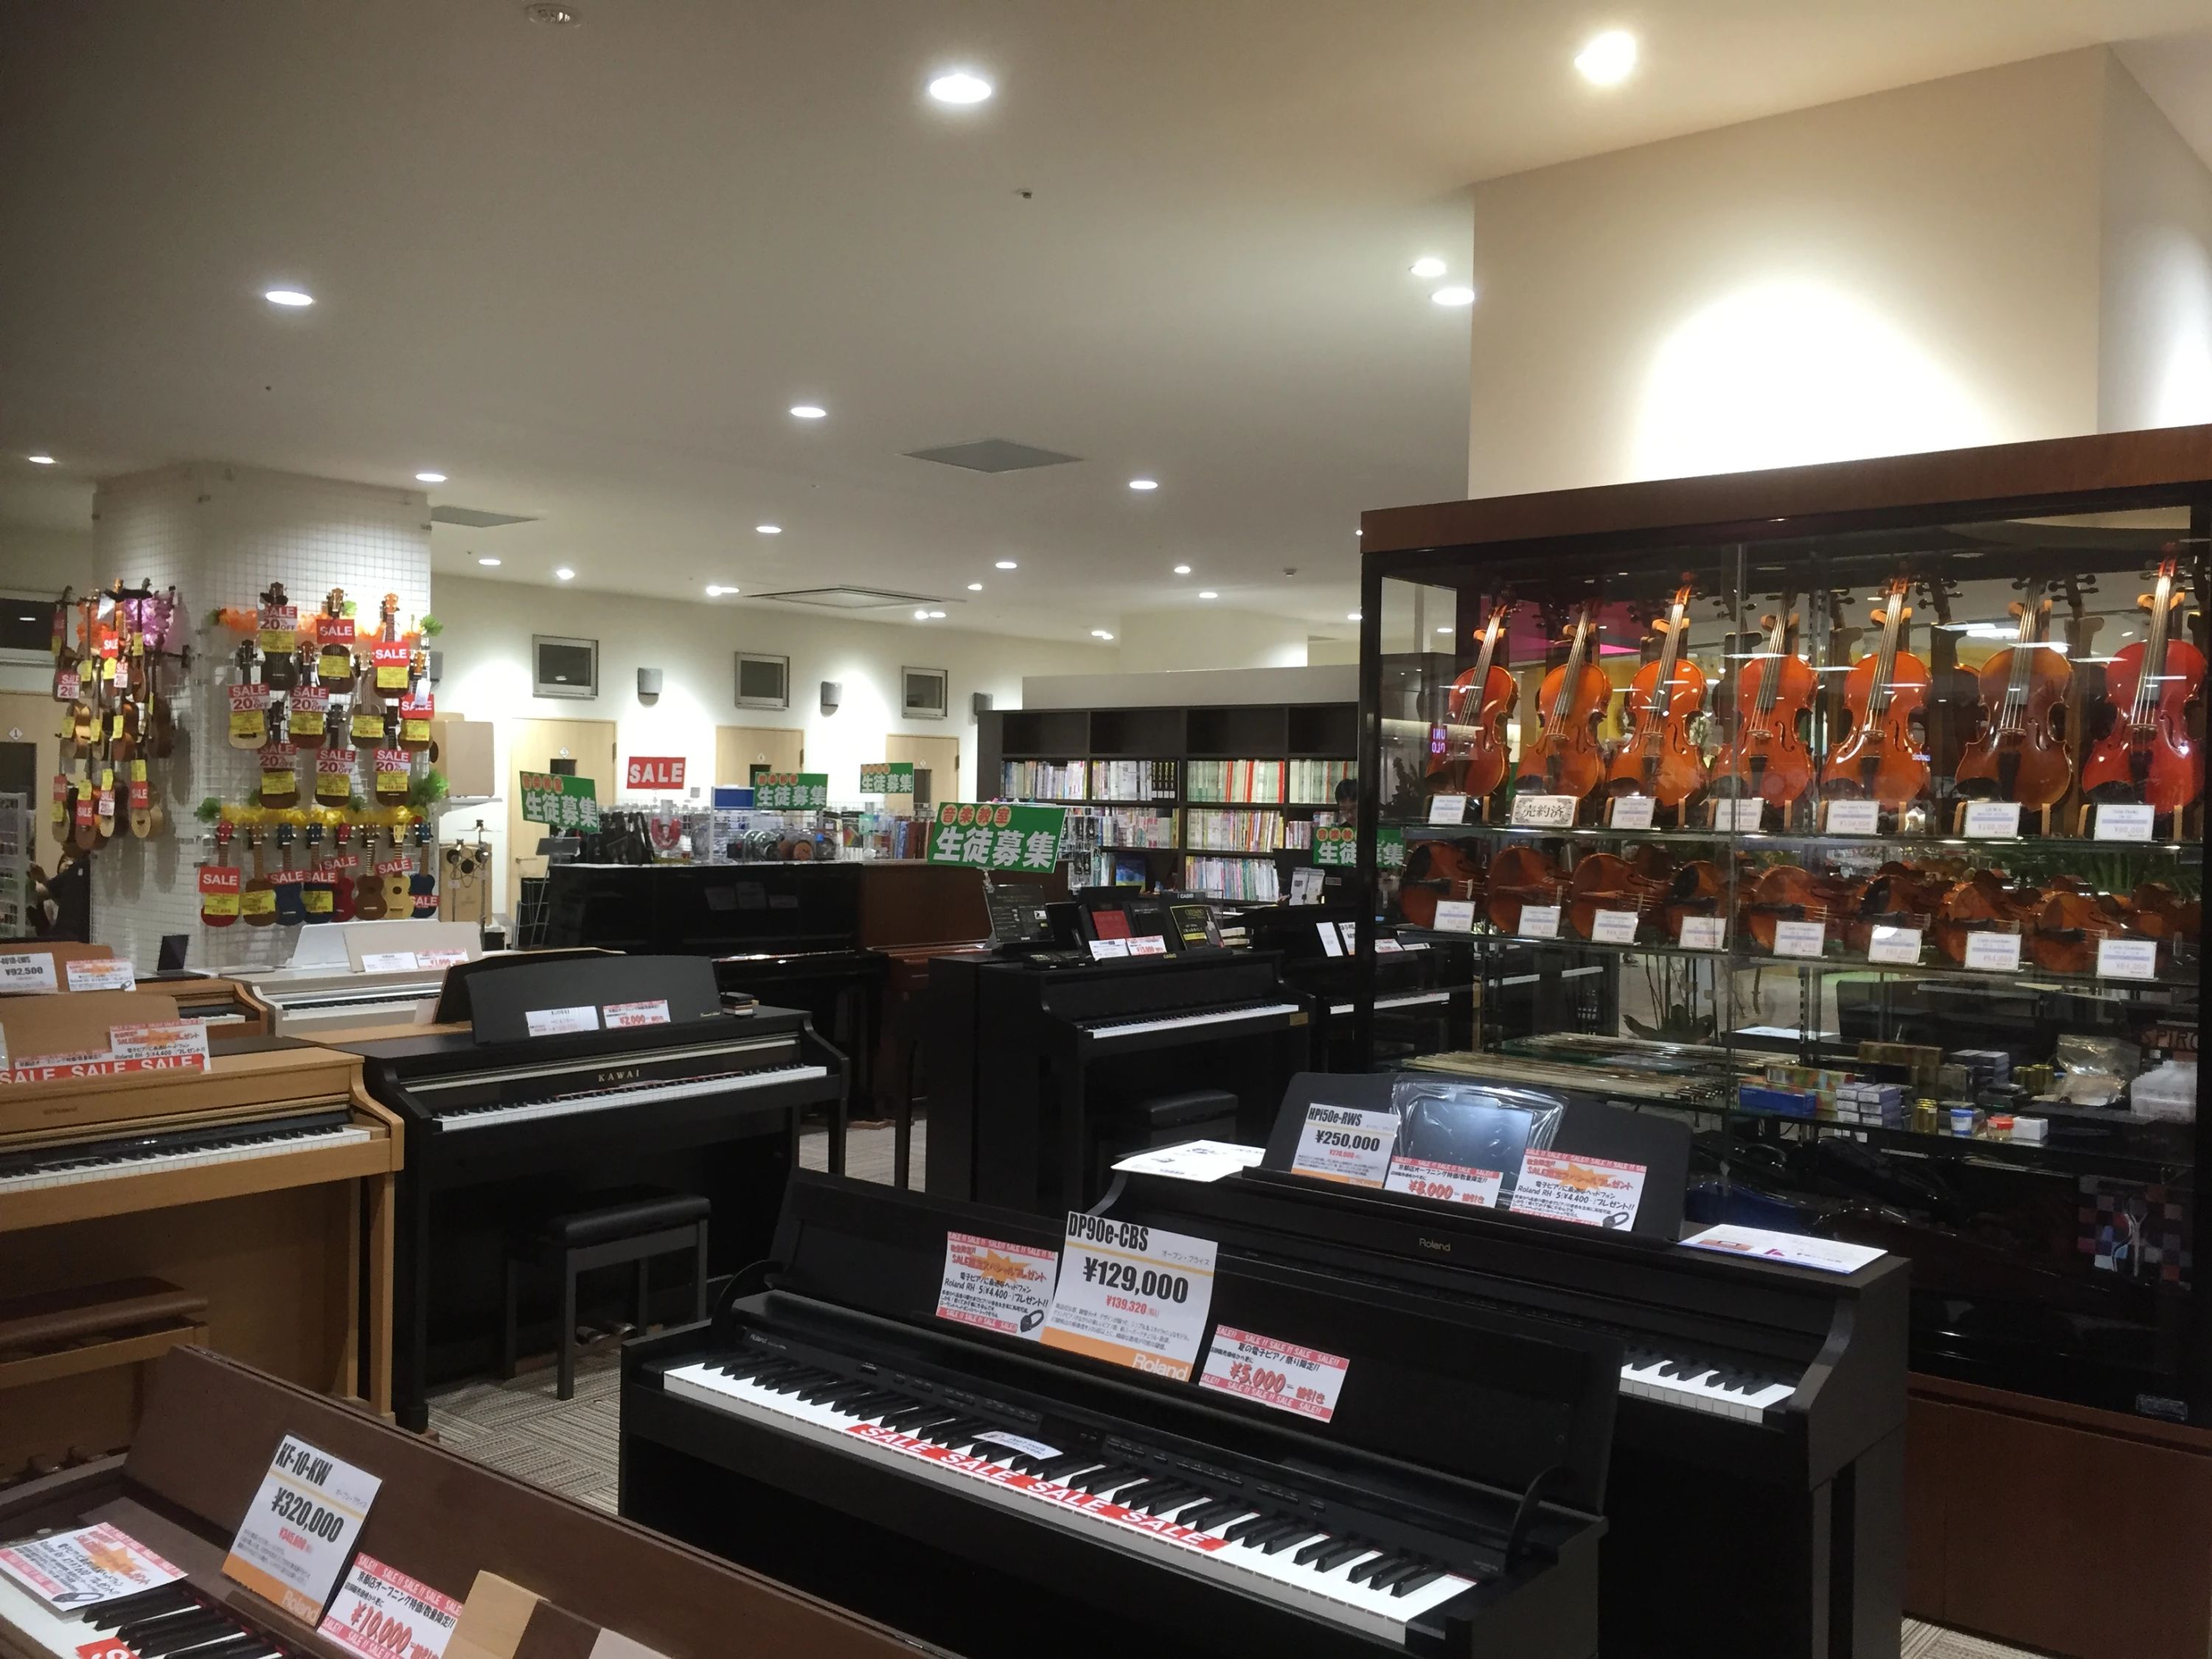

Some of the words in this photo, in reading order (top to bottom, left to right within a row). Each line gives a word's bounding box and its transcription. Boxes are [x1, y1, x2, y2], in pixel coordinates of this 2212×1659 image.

[265, 607, 295, 617] SALE
[320, 626, 352, 636] SALE
[104, 639, 118, 650] SALE
[375, 649, 407, 659] SALE
[61, 675, 80, 684] SALE
[232, 685, 267, 697] SALE
[293, 687, 327, 698] SALE
[320, 750, 352, 761] SALE
[377, 750, 408, 762] SALE
[629, 762, 684, 784] SALE
[861, 773, 912, 793] 生徒募集
[757, 785, 827, 807] 生徒募集
[526, 790, 597, 828] 生徒募集
[942, 806, 1010, 825] 音楽教室
[1522, 804, 1565, 818] 売約済
[933, 826, 1056, 869] 生徒募集
[324, 857, 358, 870] SALE
[378, 860, 410, 874] SALE
[203, 874, 237, 886] SALE
[271, 871, 304, 883] SALE
[306, 872, 335, 883] SALE
[5, 967, 44, 975] ¥92,500
[0, 1068, 55, 1084] SALE
[72, 1061, 126, 1077] SALE
[141, 1055, 193, 1070] SALE
[598, 1069, 640, 1082] KAWAI
[1315, 1129, 1380, 1152] ¥250,000
[1517, 1185, 1540, 1195] Roland
[1068, 1213, 1149, 1252] DP90e-CBS
[1419, 1237, 1451, 1252] Roland
[945, 1278, 964, 1289] Roland
[1083, 1256, 1189, 1304] ¥129,000
[1131, 1353, 1189, 1382] Roland
[275, 1442, 333, 1486] KF-10-KW
[860, 1427, 929, 1454] SALE
[940, 1453, 1020, 1483] SALE
[1026, 1480, 1112, 1514] SALE
[1119, 1511, 1209, 1545] SALE
[271, 1486, 344, 1543] ¥320,000
[381, 1568, 397, 1582] SALE
[404, 1578, 420, 1594] SALE
[425, 1588, 442, 1605] SALE
[282, 1590, 321, 1620] Roland
